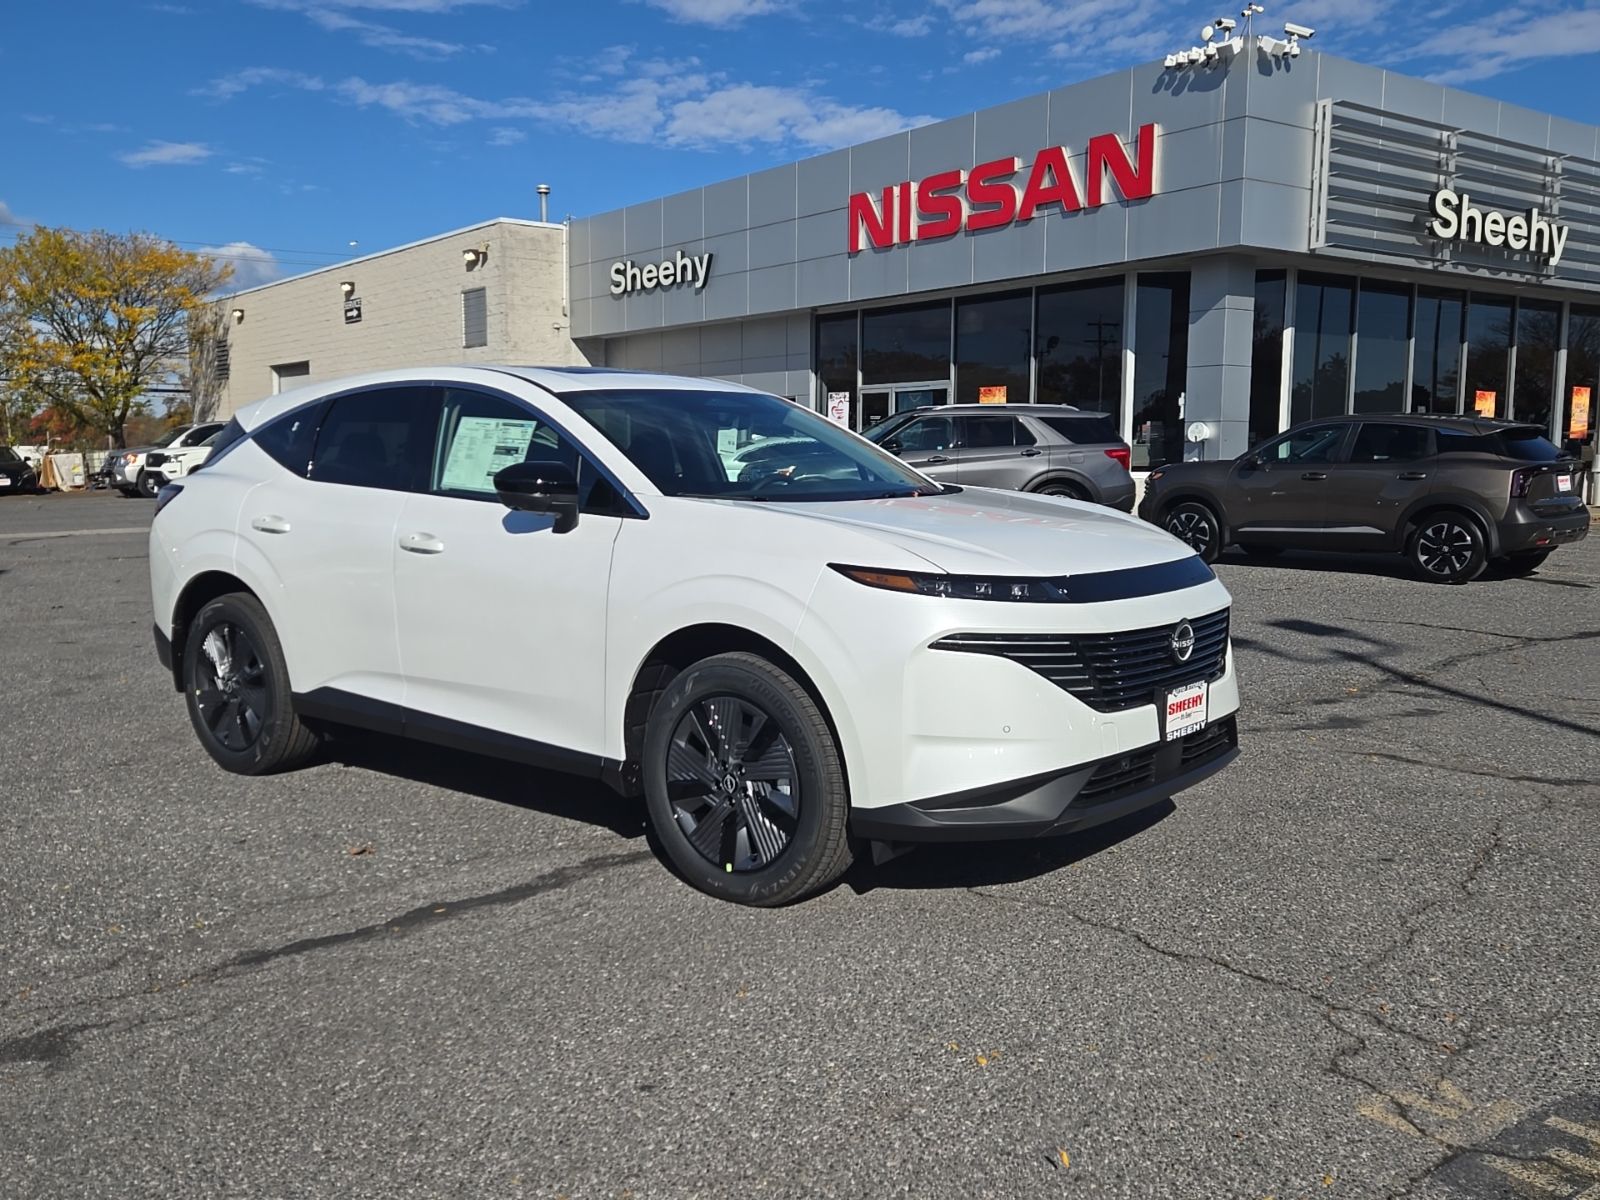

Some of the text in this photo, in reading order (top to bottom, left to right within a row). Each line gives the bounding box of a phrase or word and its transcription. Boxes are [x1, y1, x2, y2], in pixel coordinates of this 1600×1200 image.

[848, 122, 1157, 254] NISSAN
[1432, 189, 1569, 266] Sheehy
[610, 250, 710, 294] Sheehy
[1168, 693, 1204, 716] SHEEHY
[1166, 720, 1206, 742] SHEEHY
